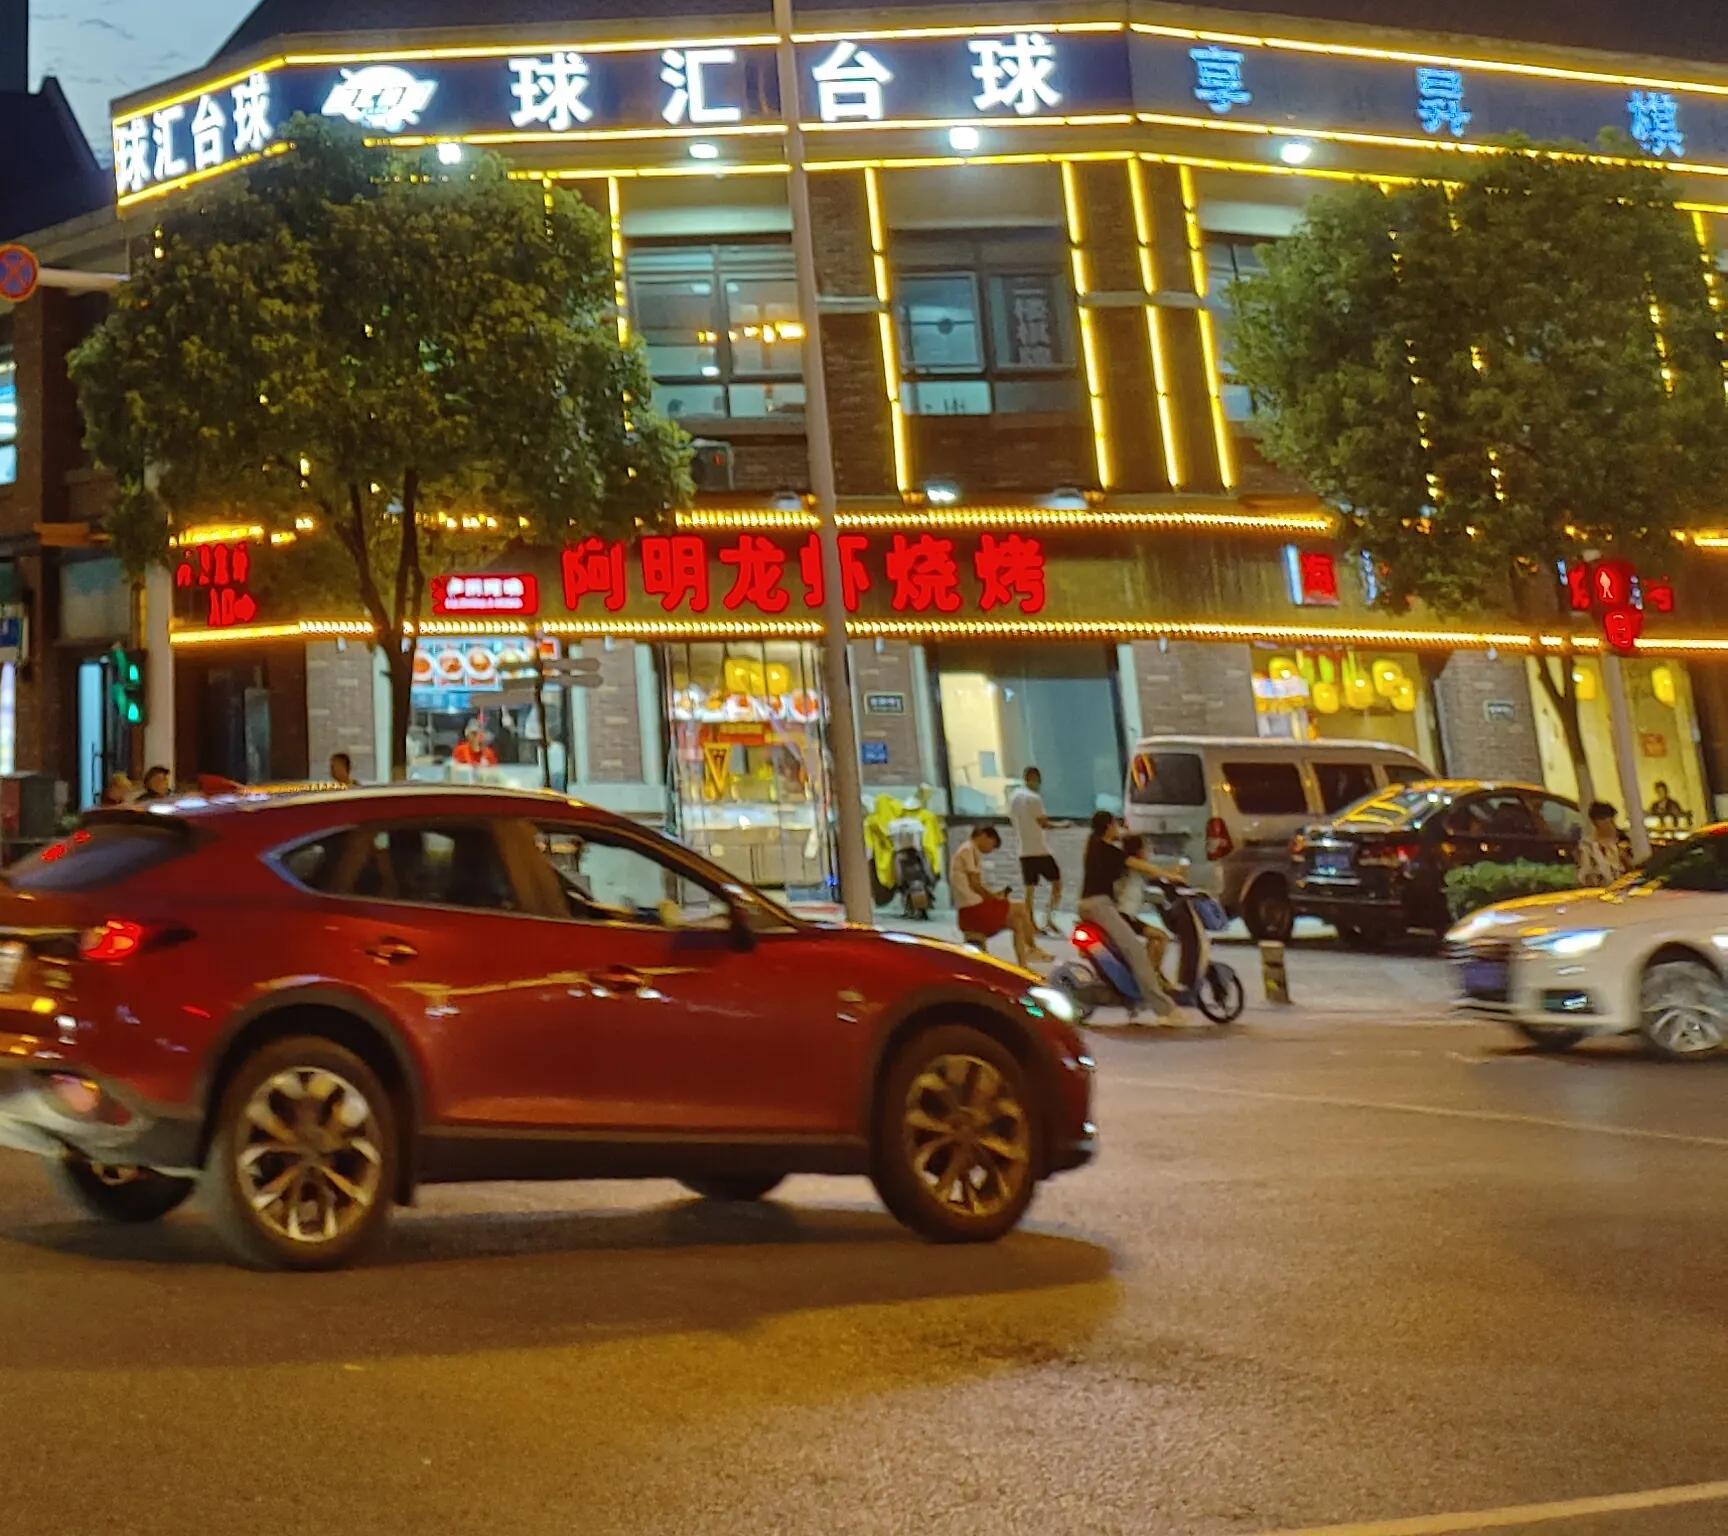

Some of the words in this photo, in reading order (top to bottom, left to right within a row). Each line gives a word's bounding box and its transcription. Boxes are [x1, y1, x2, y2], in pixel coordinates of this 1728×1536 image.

[508, 31, 1063, 130] 球汇台球
[114, 72, 273, 193] 球汇台球
[560, 533, 1046, 614] 阿明龙虾烧烤
